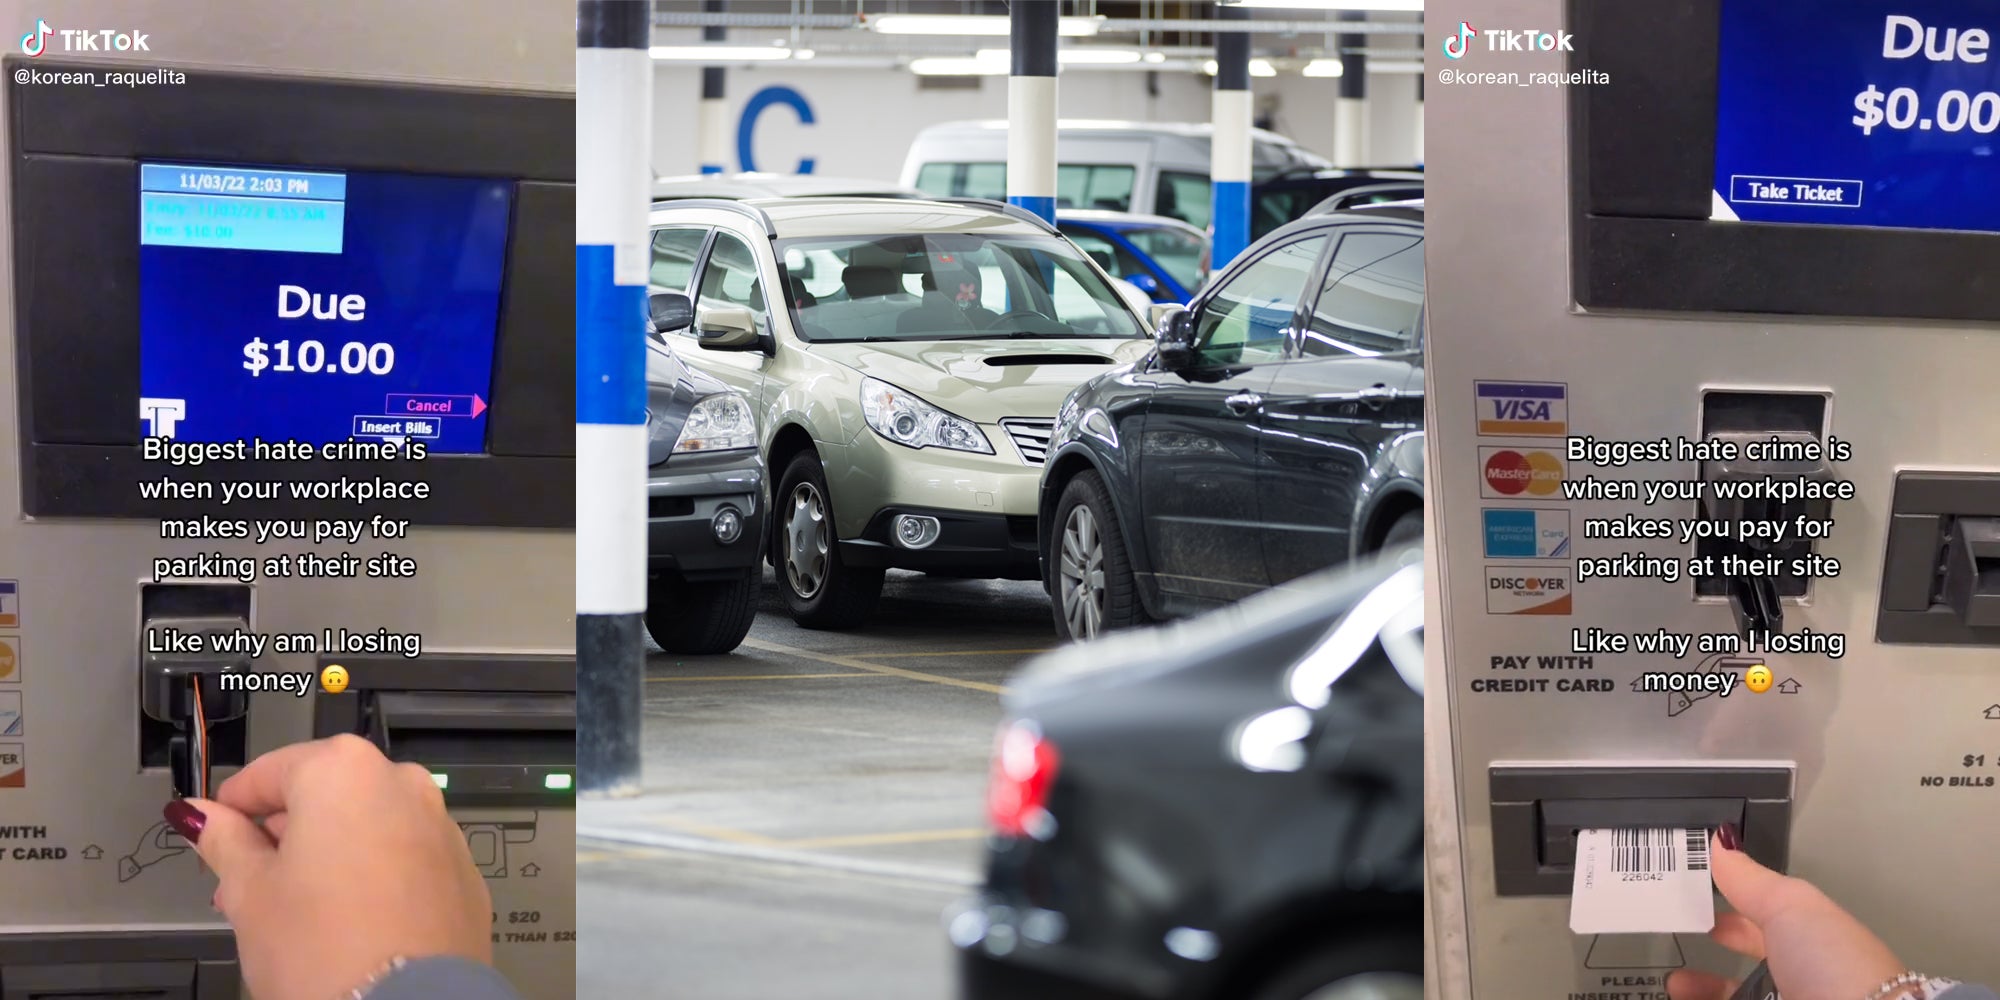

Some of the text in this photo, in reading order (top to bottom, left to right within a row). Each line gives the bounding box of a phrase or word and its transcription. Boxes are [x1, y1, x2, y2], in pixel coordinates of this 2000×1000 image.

[1882, 15, 1990, 63] Due
[1852, 84, 2000, 135] $0.00
[180, 173, 309, 194] 11/03/22 2:03 PM
[1748, 181, 1844, 202] Take Ticket
[278, 284, 366, 321] Due
[243, 336, 395, 377] $10.00
[406, 399, 452, 413] Cancel
[1492, 399, 1551, 421] VISA
[360, 420, 433, 435] Insert Bills
[1487, 467, 1560, 480] MasterCard
[1541, 529, 1565, 538] Card
[1490, 577, 1565, 590] DISCOVER
[1490, 656, 1594, 670] PAY WITH
[1470, 679, 1615, 693] CREDIT CARD
[1962, 754, 1985, 768] $1
[1920, 776, 1995, 787] NO BILLS
[12, 847, 68, 860] CARD
[1622, 872, 1664, 881] 226042
[508, 911, 541, 924] $20
[505, 931, 547, 942] THAN
